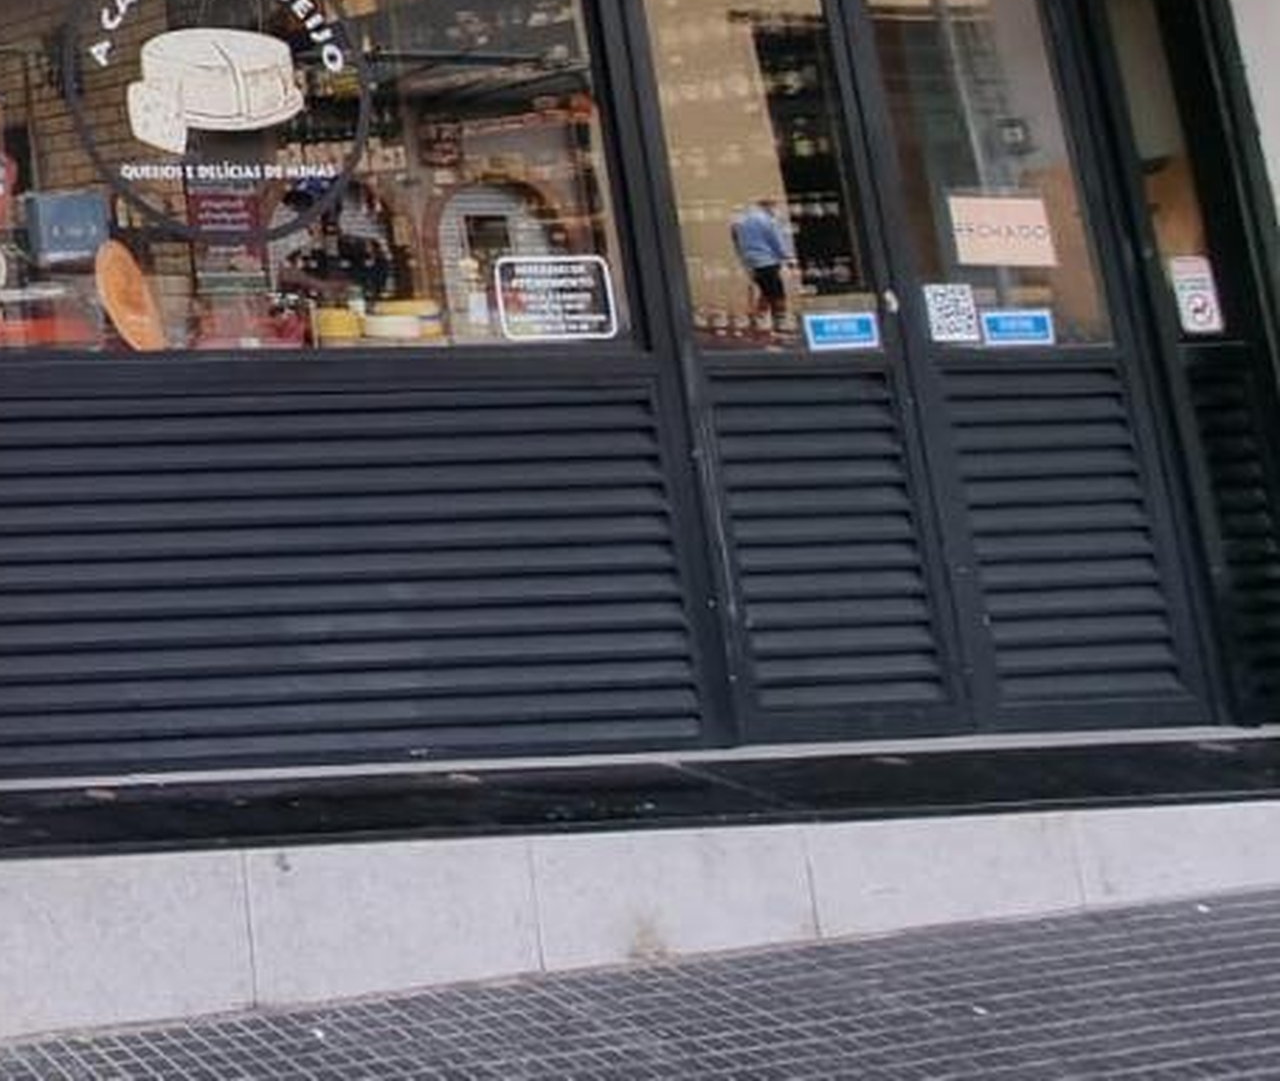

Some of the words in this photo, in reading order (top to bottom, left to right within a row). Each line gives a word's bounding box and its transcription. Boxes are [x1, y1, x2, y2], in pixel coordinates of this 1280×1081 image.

[90, 40, 113, 67] A
[121, 164, 183, 181] QUEIJOS
[186, 164, 195, 179] E
